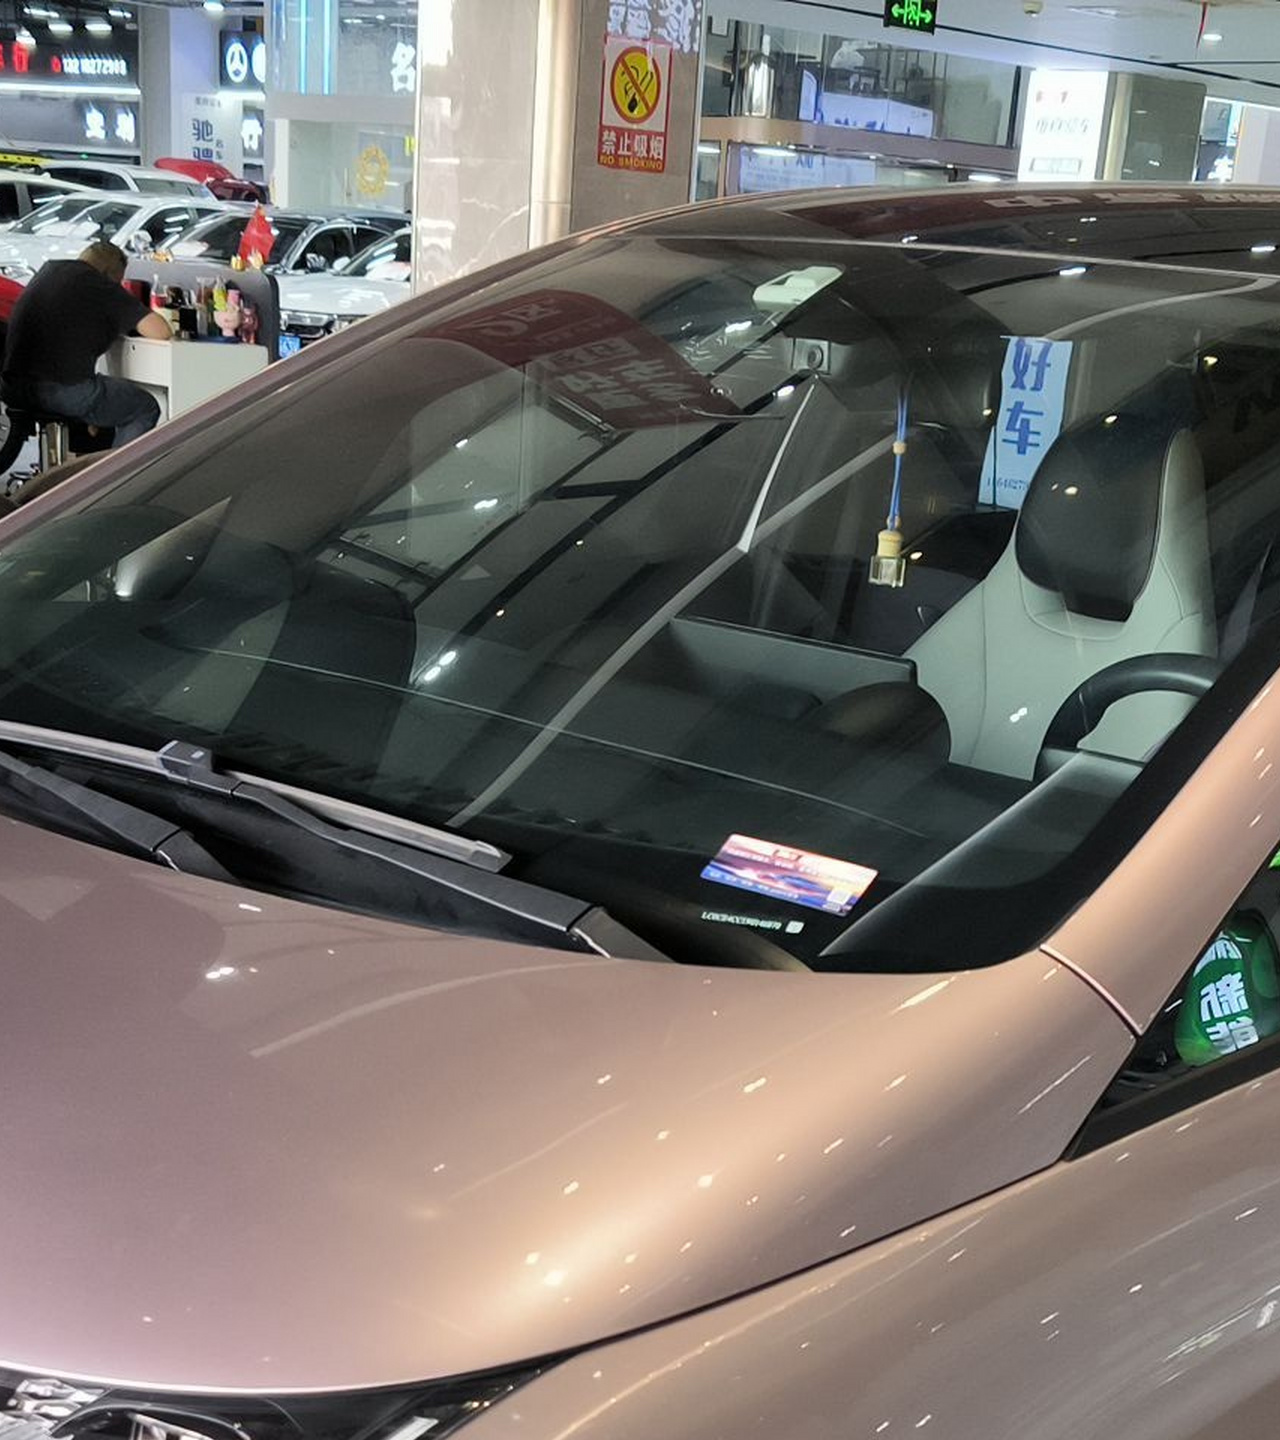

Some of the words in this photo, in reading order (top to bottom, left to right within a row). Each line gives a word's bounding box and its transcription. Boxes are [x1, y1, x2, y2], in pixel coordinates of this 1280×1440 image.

[601, 130, 665, 160] 禁止吸烟
[600, 154, 615, 165] NO
[618, 156, 663, 170] SMOKING
[1001, 337, 1054, 455] 好车
